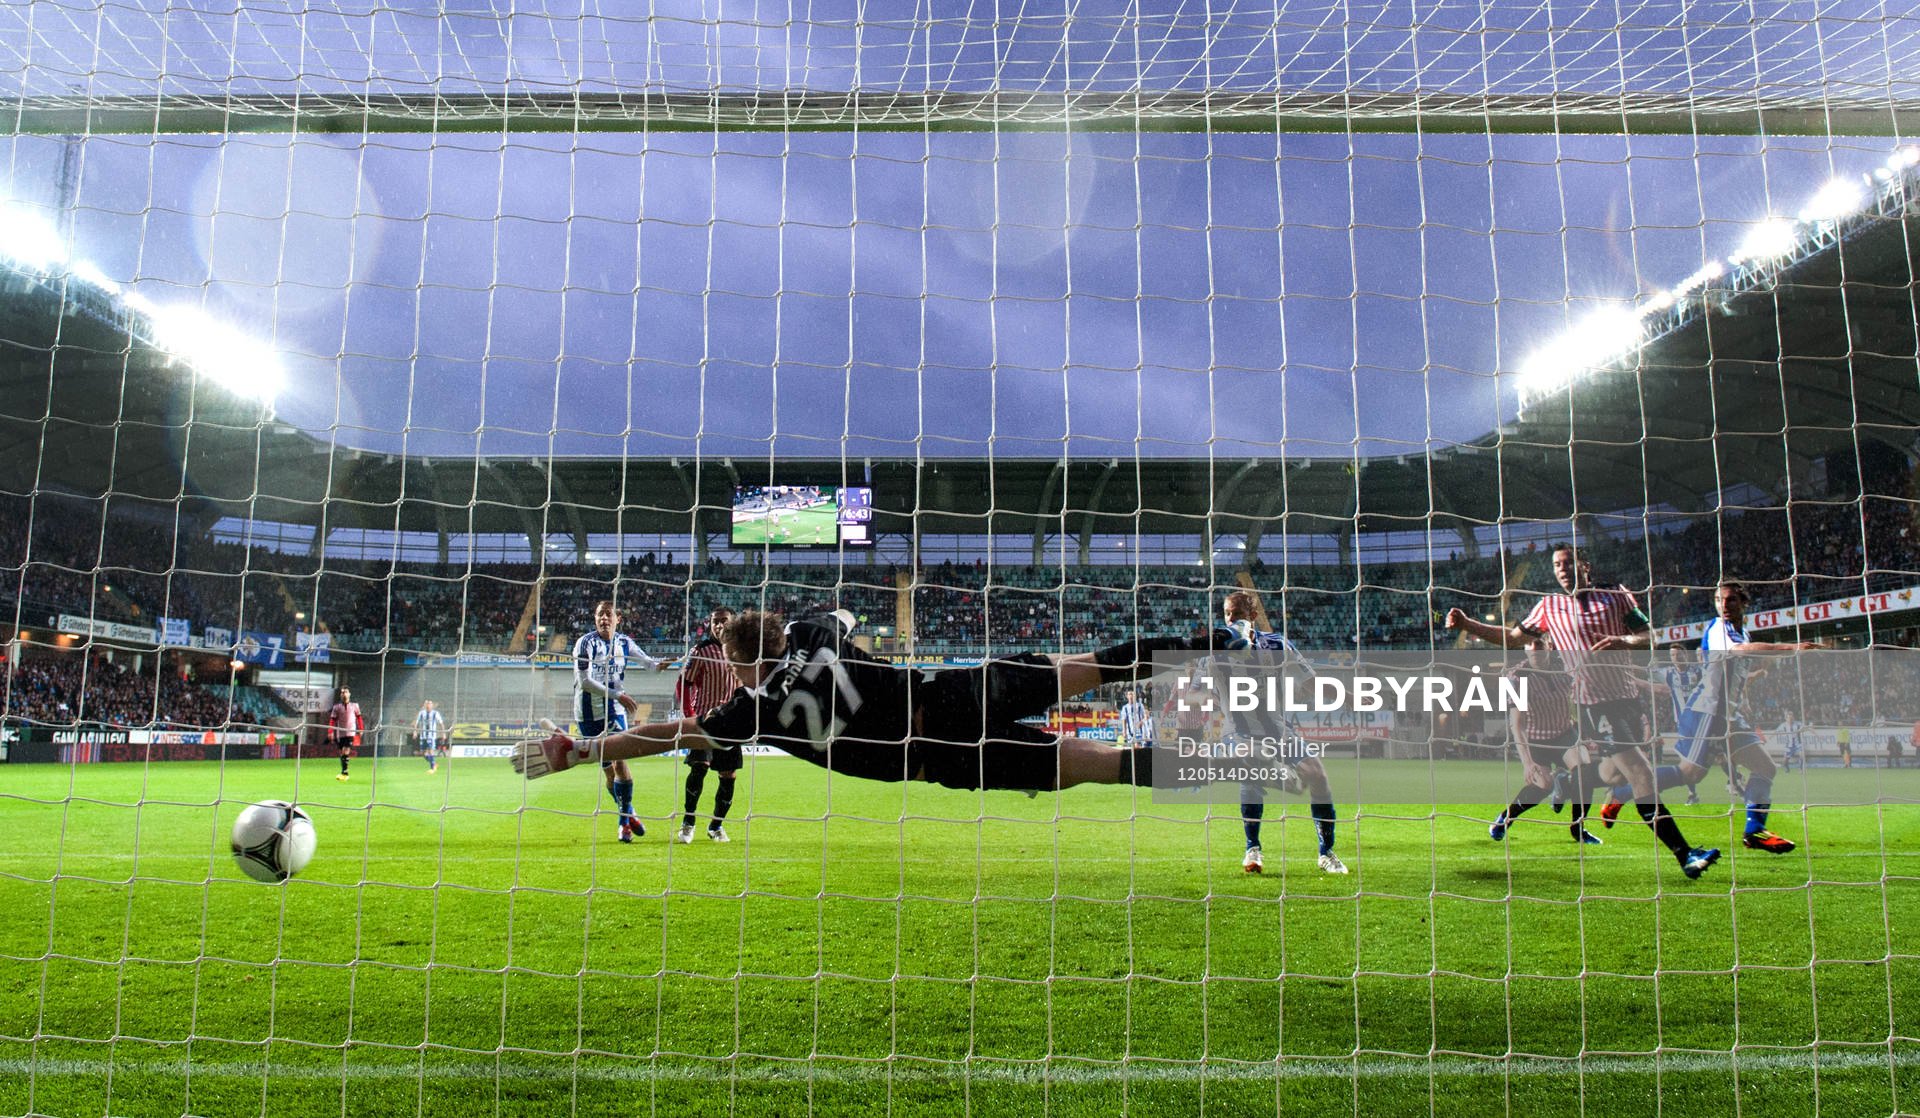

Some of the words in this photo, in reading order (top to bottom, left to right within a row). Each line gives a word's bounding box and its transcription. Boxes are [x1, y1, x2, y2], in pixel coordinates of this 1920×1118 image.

[1804, 603, 1832, 621] GT
[1859, 593, 1891, 613] GT
[1754, 611, 1780, 628] GT
[1669, 626, 1689, 640] GT
[777, 646, 864, 752] 27
[1598, 715, 1612, 733] 4
[1079, 727, 1114, 740] arctic
